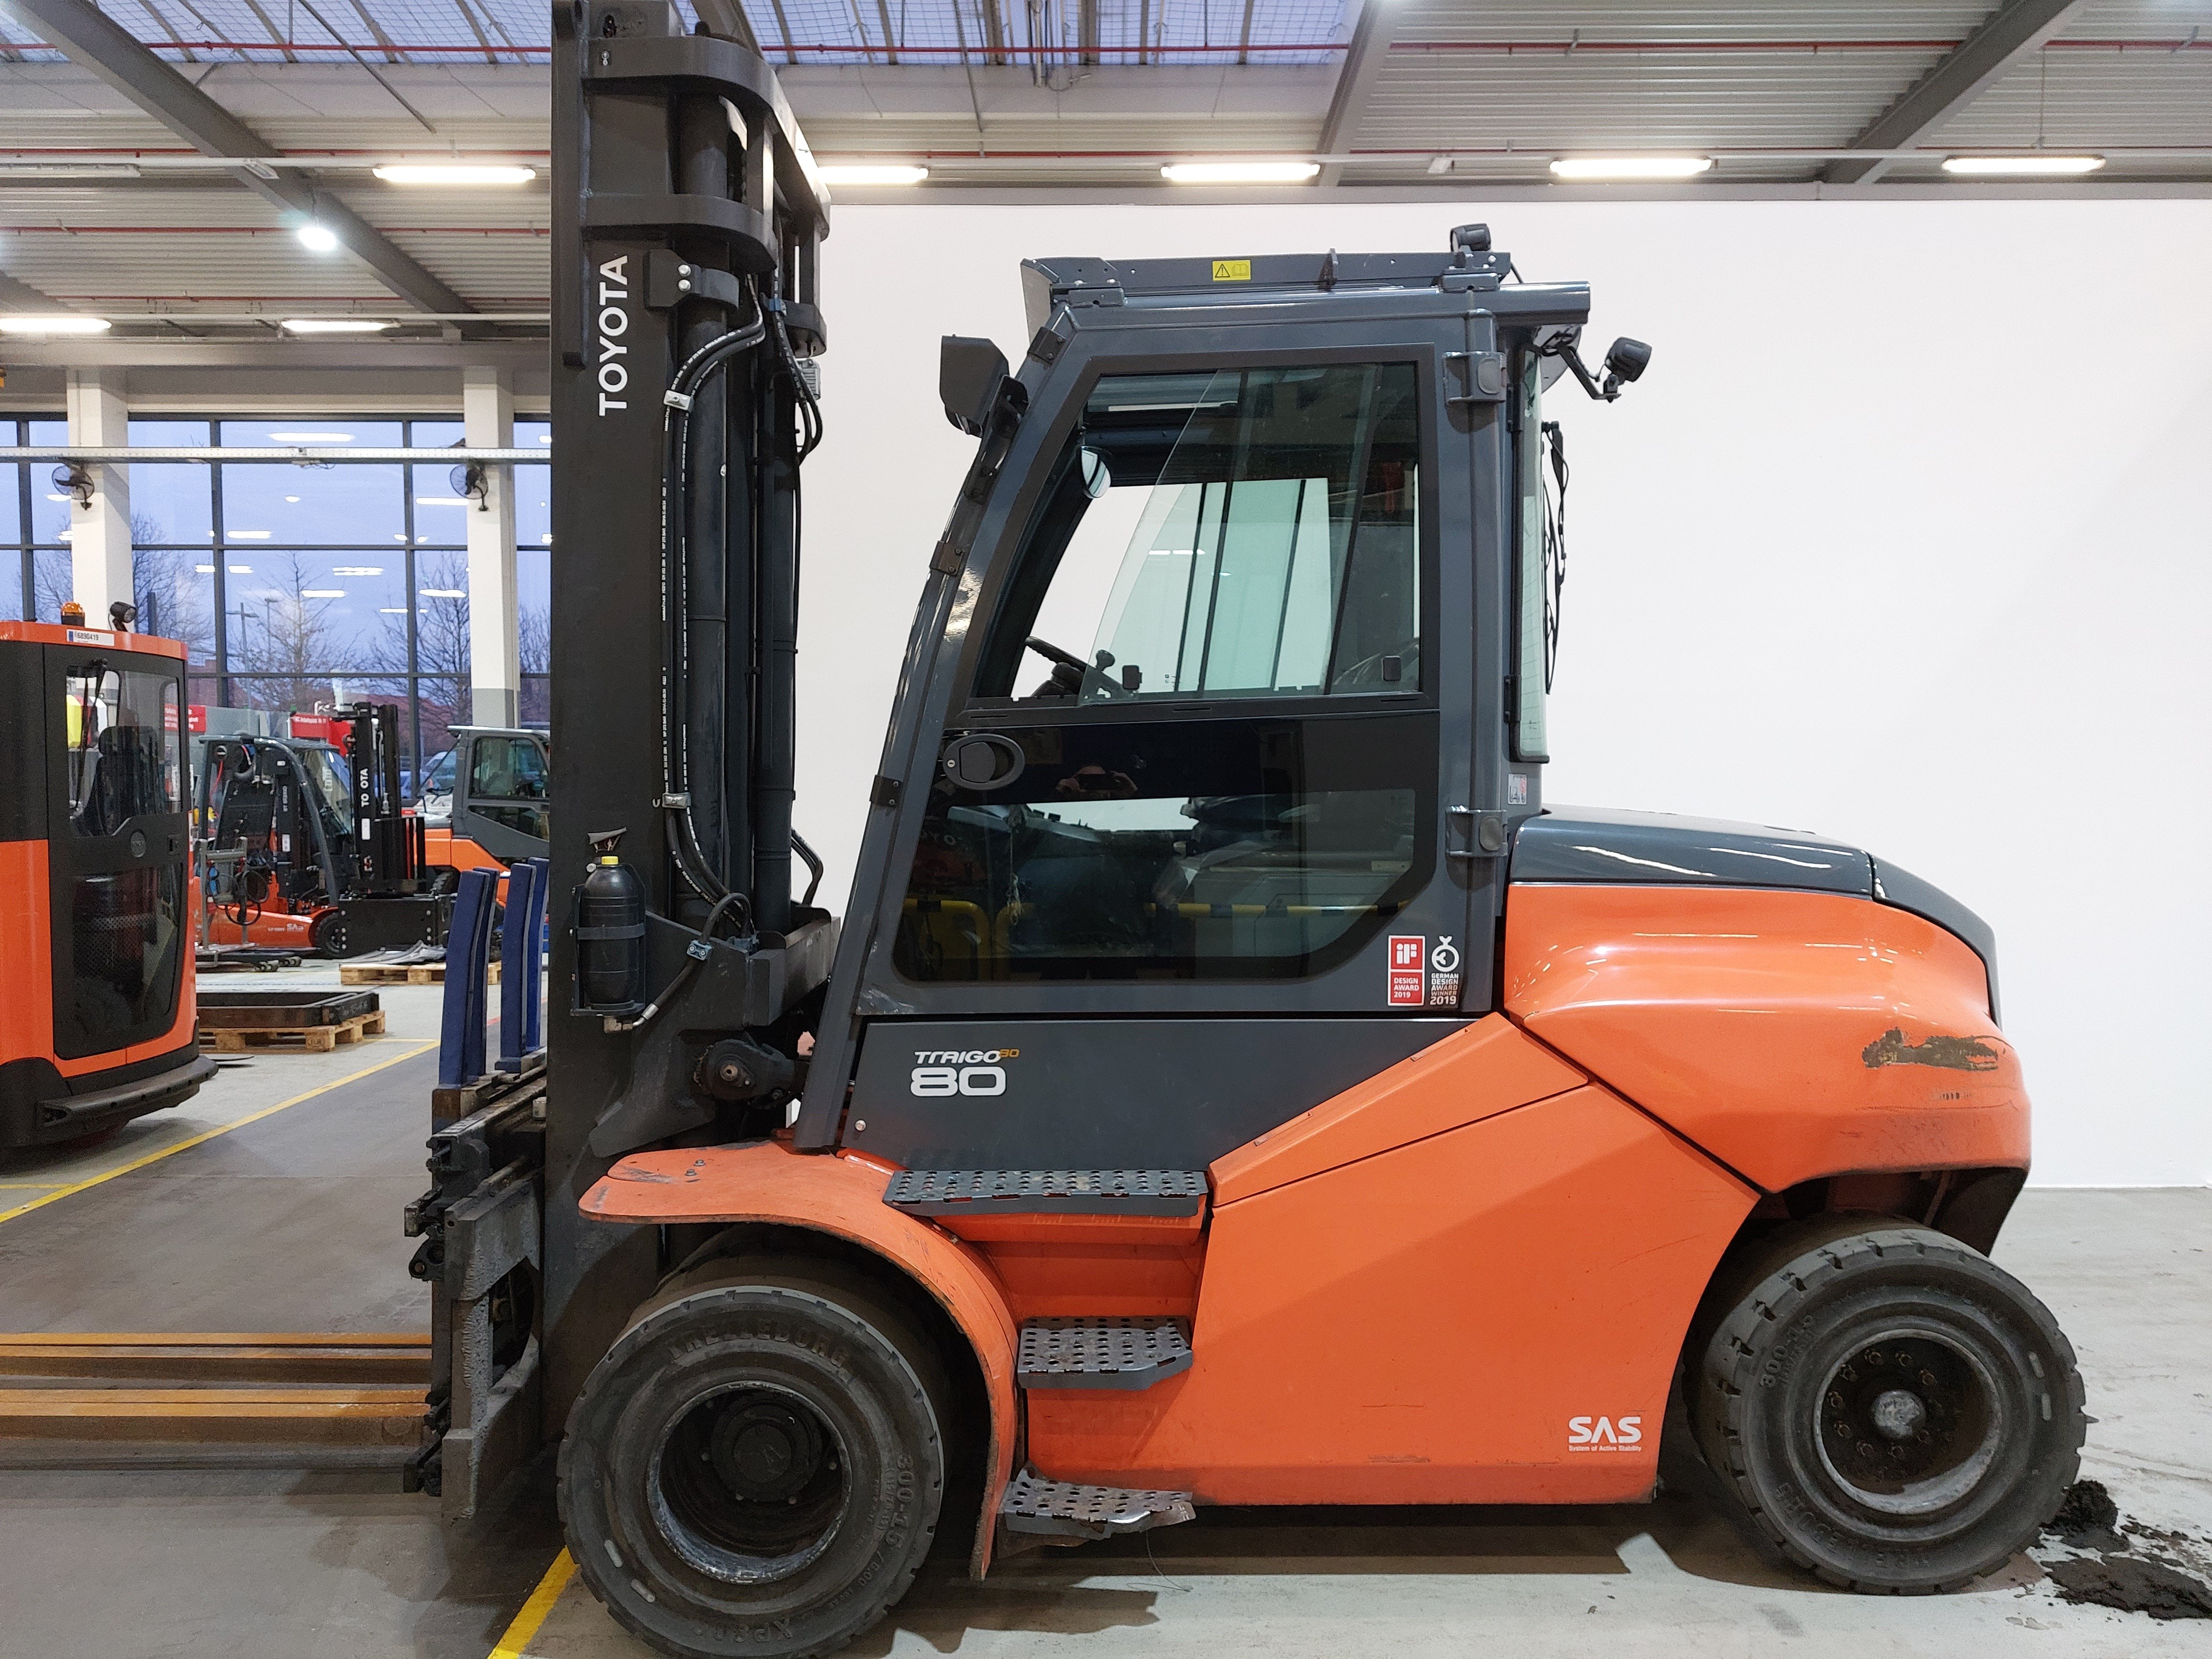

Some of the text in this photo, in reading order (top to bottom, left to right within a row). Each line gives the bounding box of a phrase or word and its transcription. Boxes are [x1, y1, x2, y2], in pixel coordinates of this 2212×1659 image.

[598, 255, 628, 417] TOYOTA
[1429, 996, 1457, 1005] 2019
[910, 1066, 1006, 1096] 80
[1569, 1416, 1642, 1444] SAS
[886, 1454, 915, 1548] 300-15
